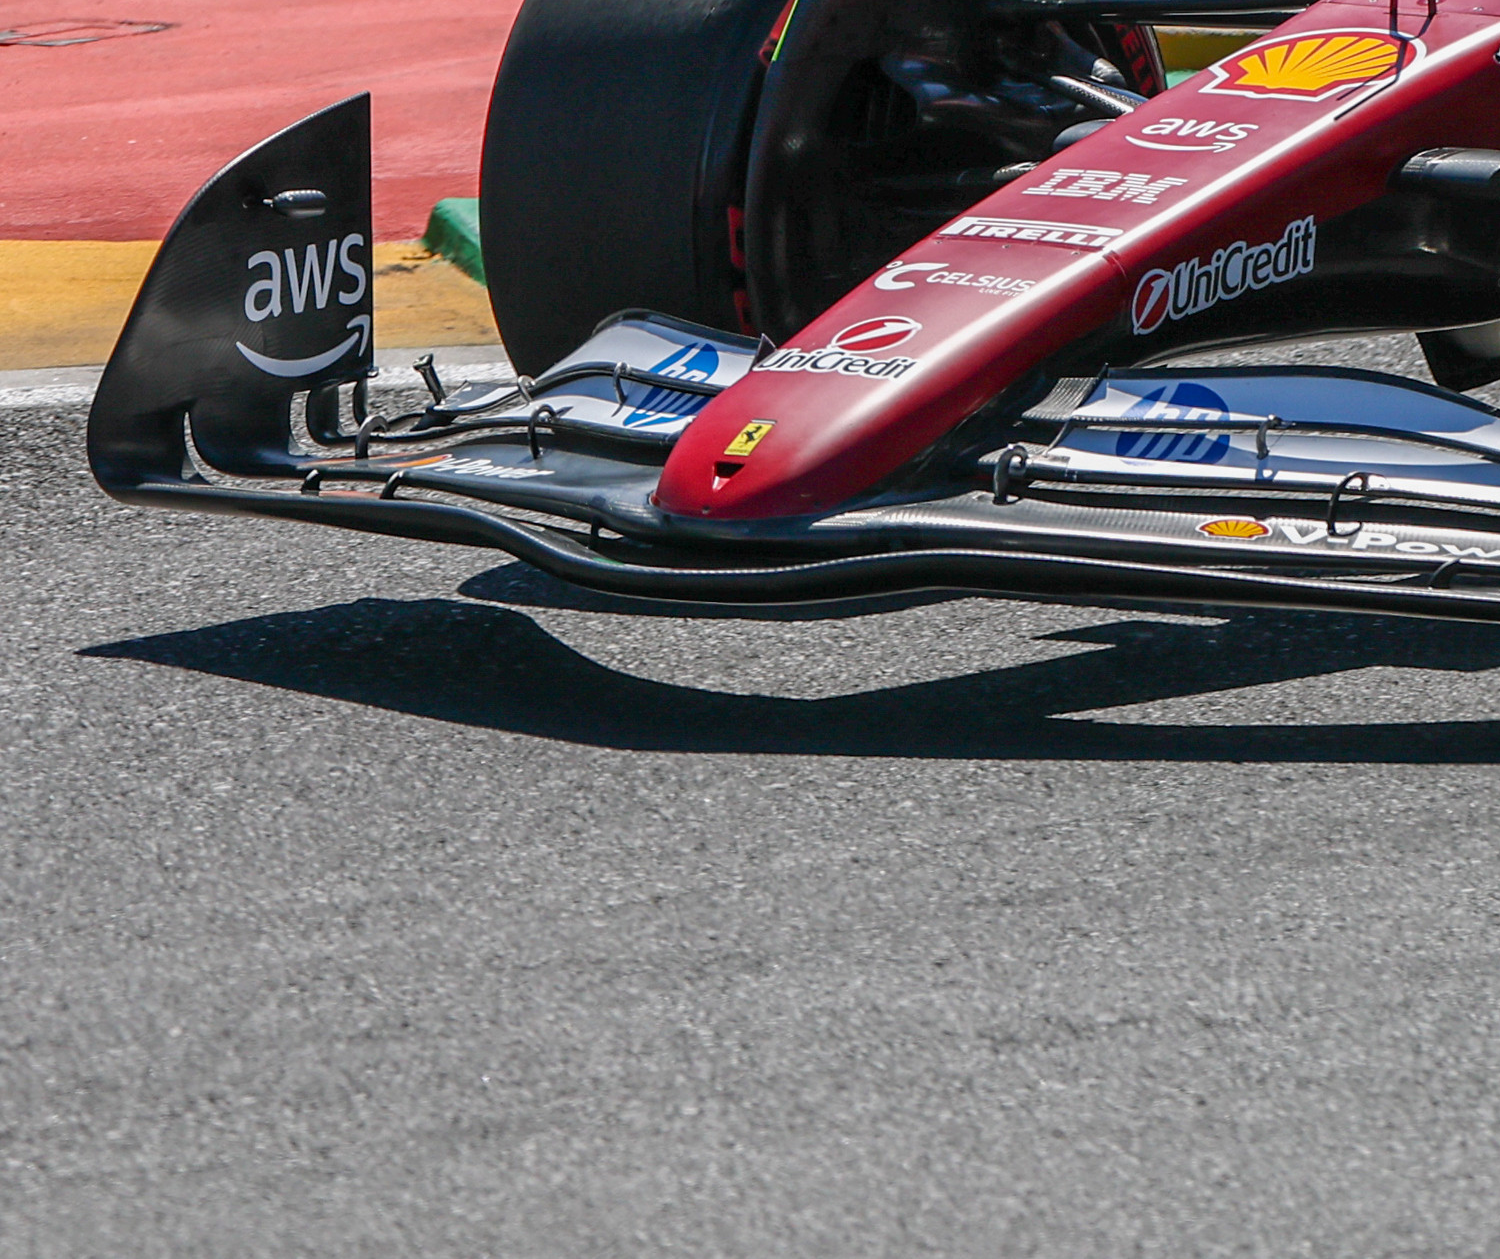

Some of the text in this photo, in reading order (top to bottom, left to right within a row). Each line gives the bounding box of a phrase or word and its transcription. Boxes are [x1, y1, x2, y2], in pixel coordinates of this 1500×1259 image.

[1140, 117, 1260, 140] aws
[1021, 168, 1189, 205] IBM
[938, 216, 1125, 249] PIRELLI
[244, 233, 365, 323] aws
[925, 270, 1038, 293] CELSIUS
[1168, 215, 1316, 322] UniCredit
[752, 347, 919, 382] UniCredit
